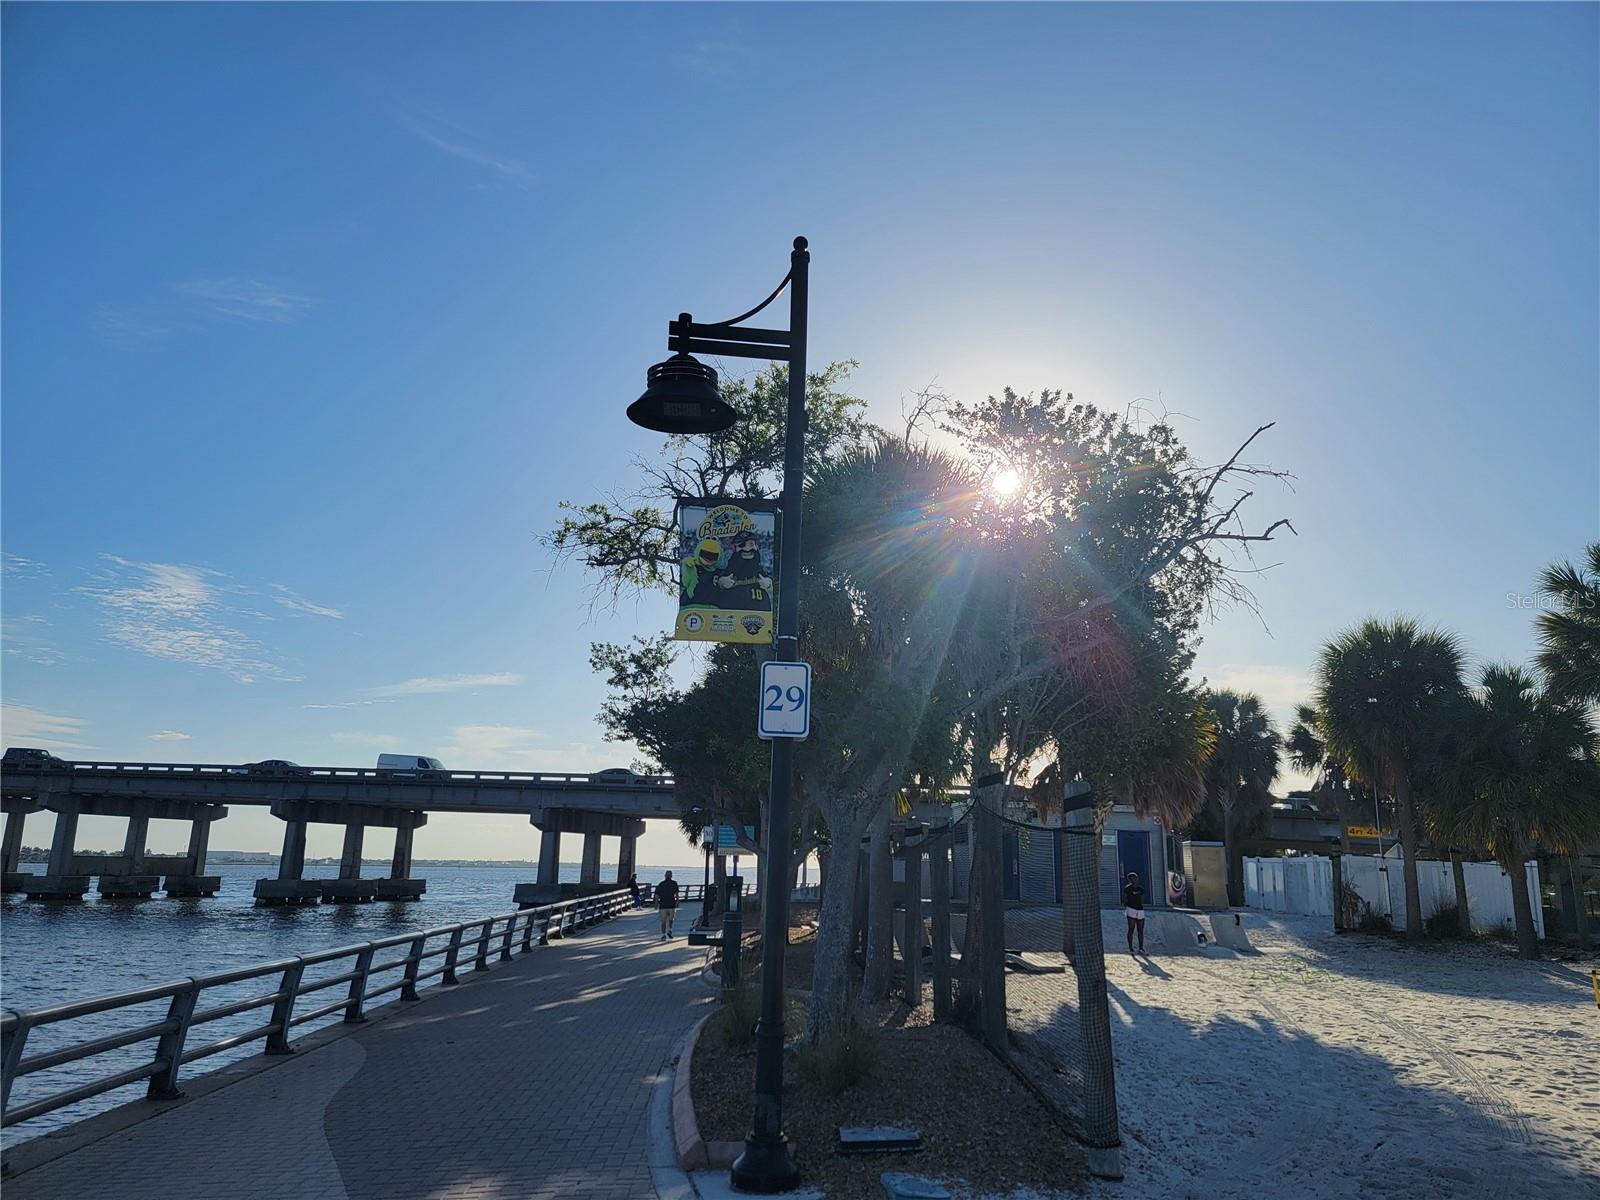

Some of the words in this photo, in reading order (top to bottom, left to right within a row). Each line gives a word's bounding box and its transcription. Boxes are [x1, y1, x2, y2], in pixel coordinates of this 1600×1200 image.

[707, 506, 739, 519] WELCOME
[699, 521, 757, 538] Bradenton
[690, 617, 698, 628] P
[765, 684, 805, 712] 29
